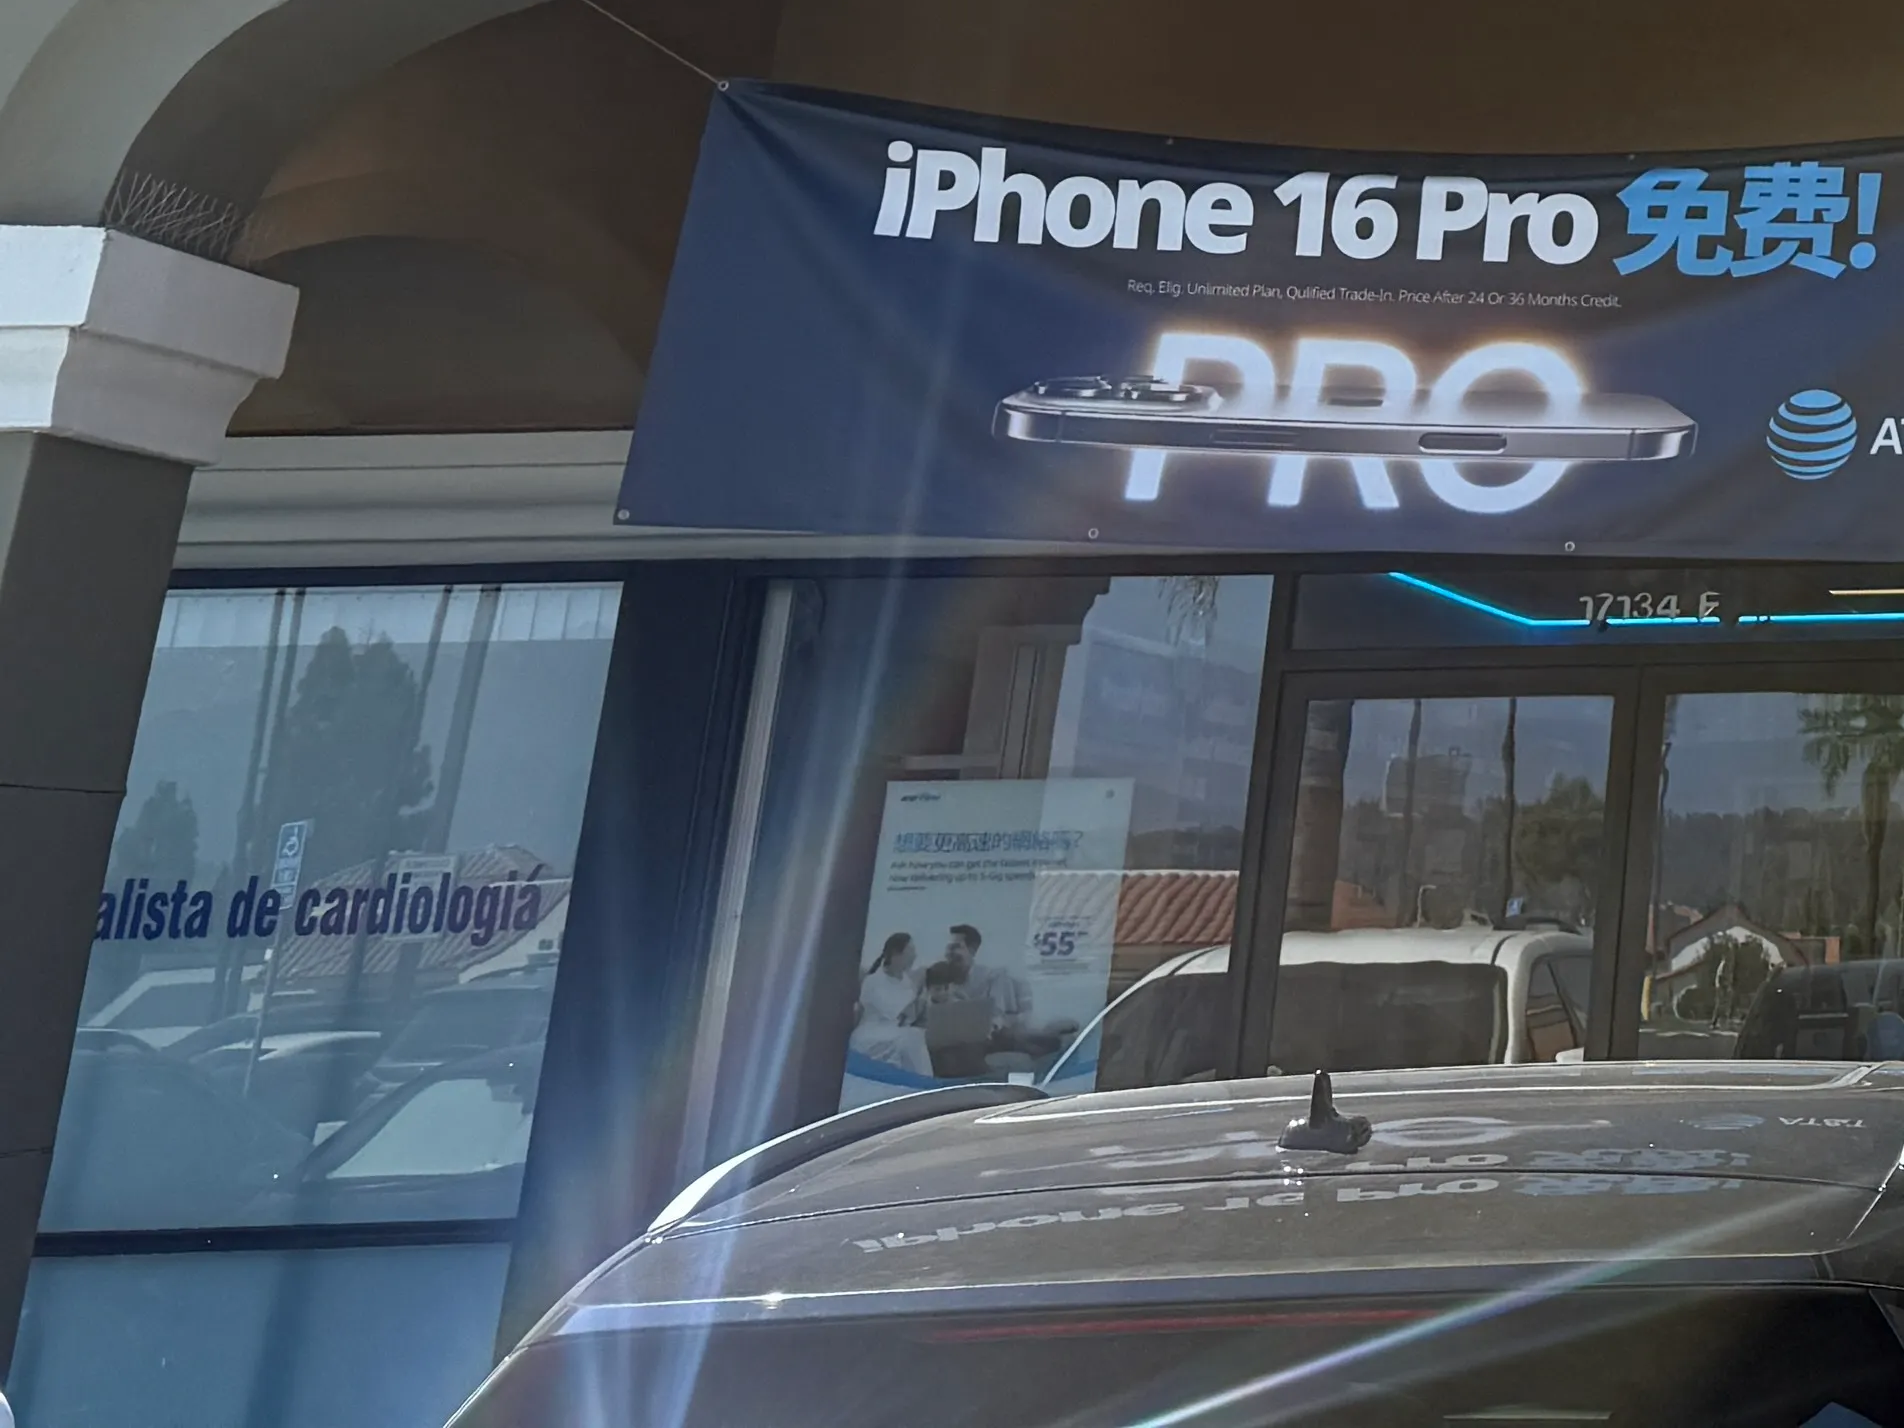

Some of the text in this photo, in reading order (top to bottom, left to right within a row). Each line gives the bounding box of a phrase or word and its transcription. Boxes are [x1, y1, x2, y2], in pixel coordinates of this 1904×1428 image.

[874, 140, 1880, 279] iPhone 16 Pro 免费!
[1187, 281, 1250, 298] Unlimited
[1398, 289, 1431, 304] Price
[1433, 290, 1465, 305] After
[1467, 291, 1485, 305] 24
[1487, 292, 1505, 306] Or
[1527, 293, 1579, 307] Months
[1124, 330, 1590, 514] PRO
[1579, 592, 1681, 621] 17134
[227, 875, 282, 938] de
